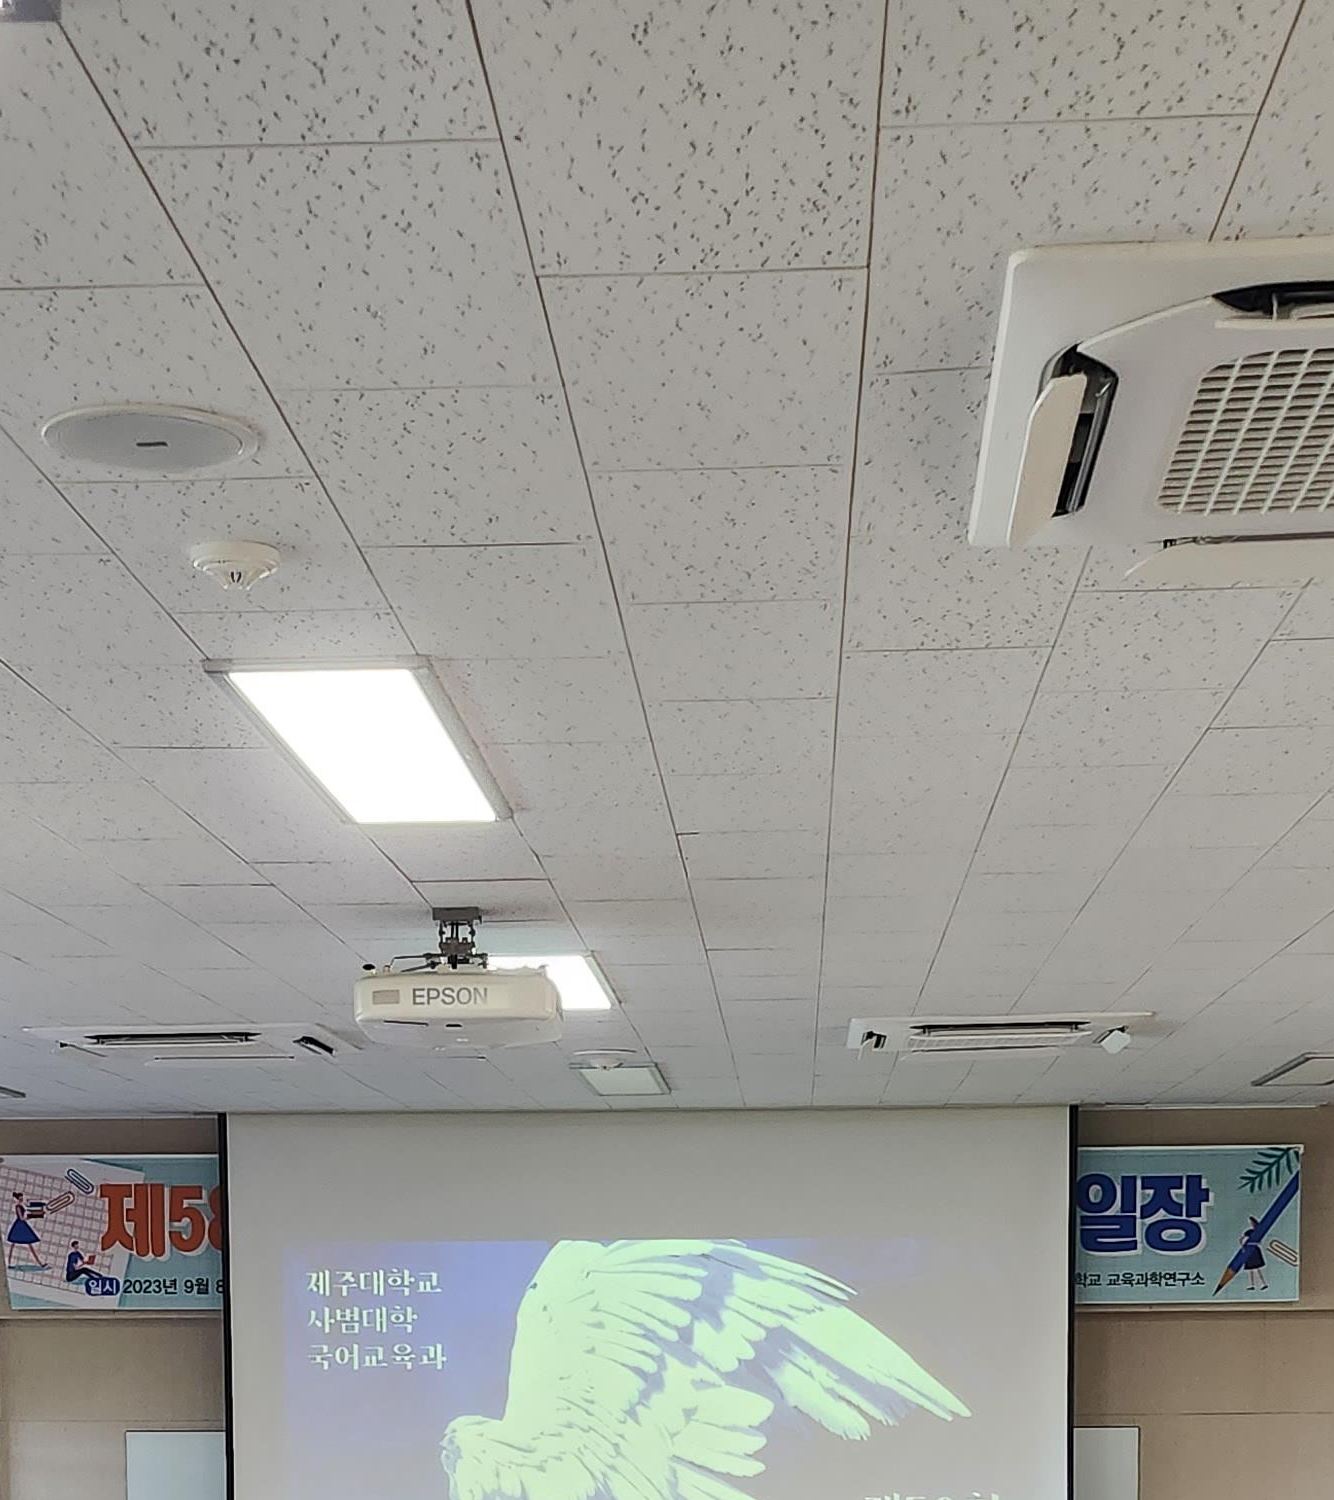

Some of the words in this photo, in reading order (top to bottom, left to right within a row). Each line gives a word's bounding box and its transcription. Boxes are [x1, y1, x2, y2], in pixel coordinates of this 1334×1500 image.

[412, 987, 488, 1005] EPSON
[1076, 1173, 1210, 1253] 일장
[88, 1279, 117, 1295] 일시
[123, 1278, 178, 1295] 2023년
[184, 1277, 210, 1295] 9월
[306, 1268, 442, 1297] 제주대학교
[1107, 1272, 1205, 1288] 교육과학연구소
[308, 1305, 419, 1334] 사범대학
[307, 1343, 447, 1371] 국어교육과
